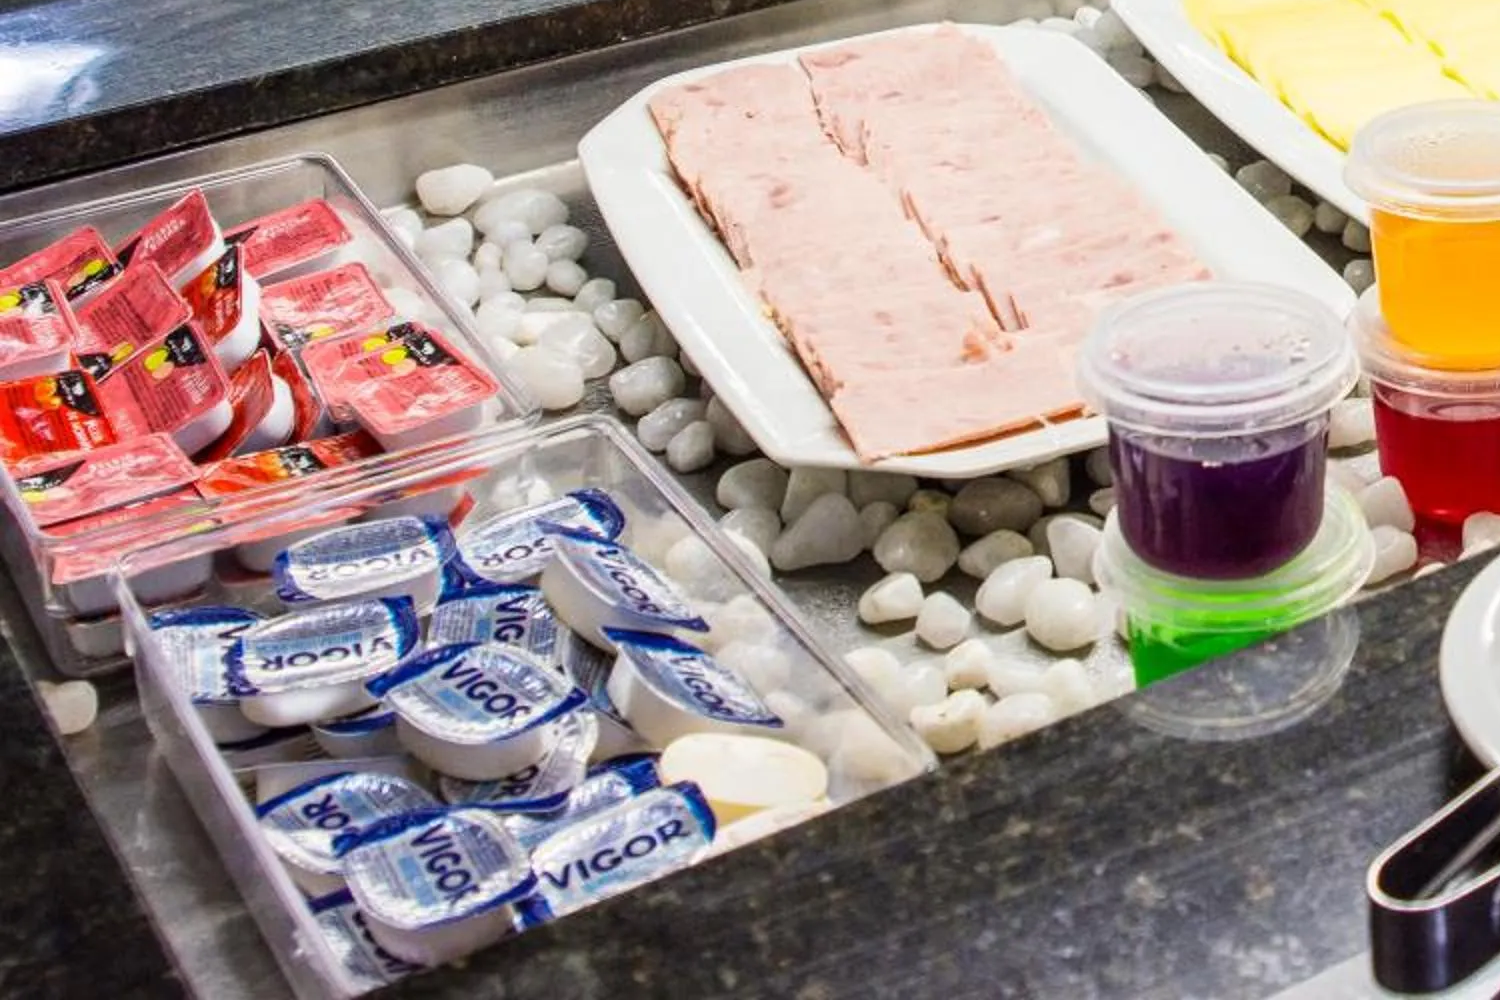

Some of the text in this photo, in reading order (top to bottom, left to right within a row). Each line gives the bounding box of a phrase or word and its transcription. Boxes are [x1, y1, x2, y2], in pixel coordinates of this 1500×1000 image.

[310, 549, 431, 580] VIGOR
[596, 549, 661, 614] VIGOR
[493, 593, 526, 643] VIG
[262, 637, 394, 671] VIGOR
[441, 657, 531, 727] VIGOR
[670, 655, 734, 717] VIGOR
[410, 823, 480, 904] VIGOR
[543, 818, 690, 890] VIGOR
